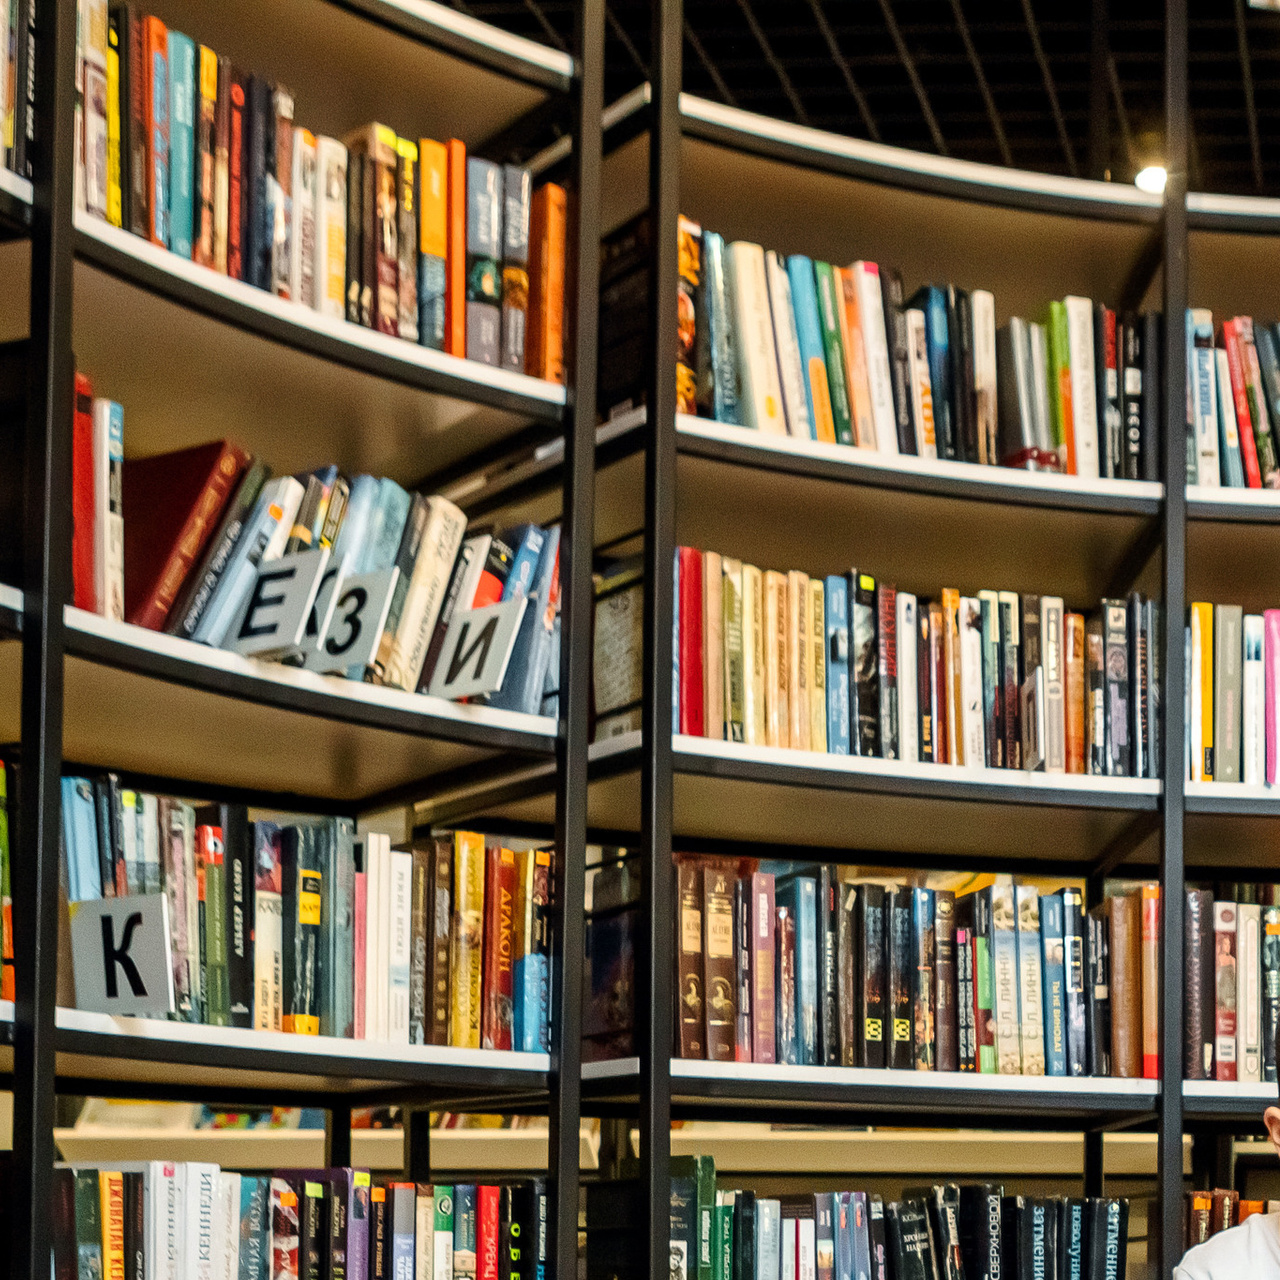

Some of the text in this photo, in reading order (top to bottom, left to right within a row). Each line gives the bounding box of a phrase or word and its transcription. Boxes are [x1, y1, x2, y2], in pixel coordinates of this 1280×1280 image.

[238, 567, 297, 639] Е
[444, 616, 500, 685] И
[101, 912, 148, 998] К
[499, 886, 511, 972] ДРАКОН
[1054, 1009, 1062, 1052] ВИНОВАТ
[199, 1173, 212, 1262] КЕННЕДИ
[988, 1194, 1000, 1280] СВЕРХНОВОЙ
[723, 1243, 731, 1280] СЕРДЦА
